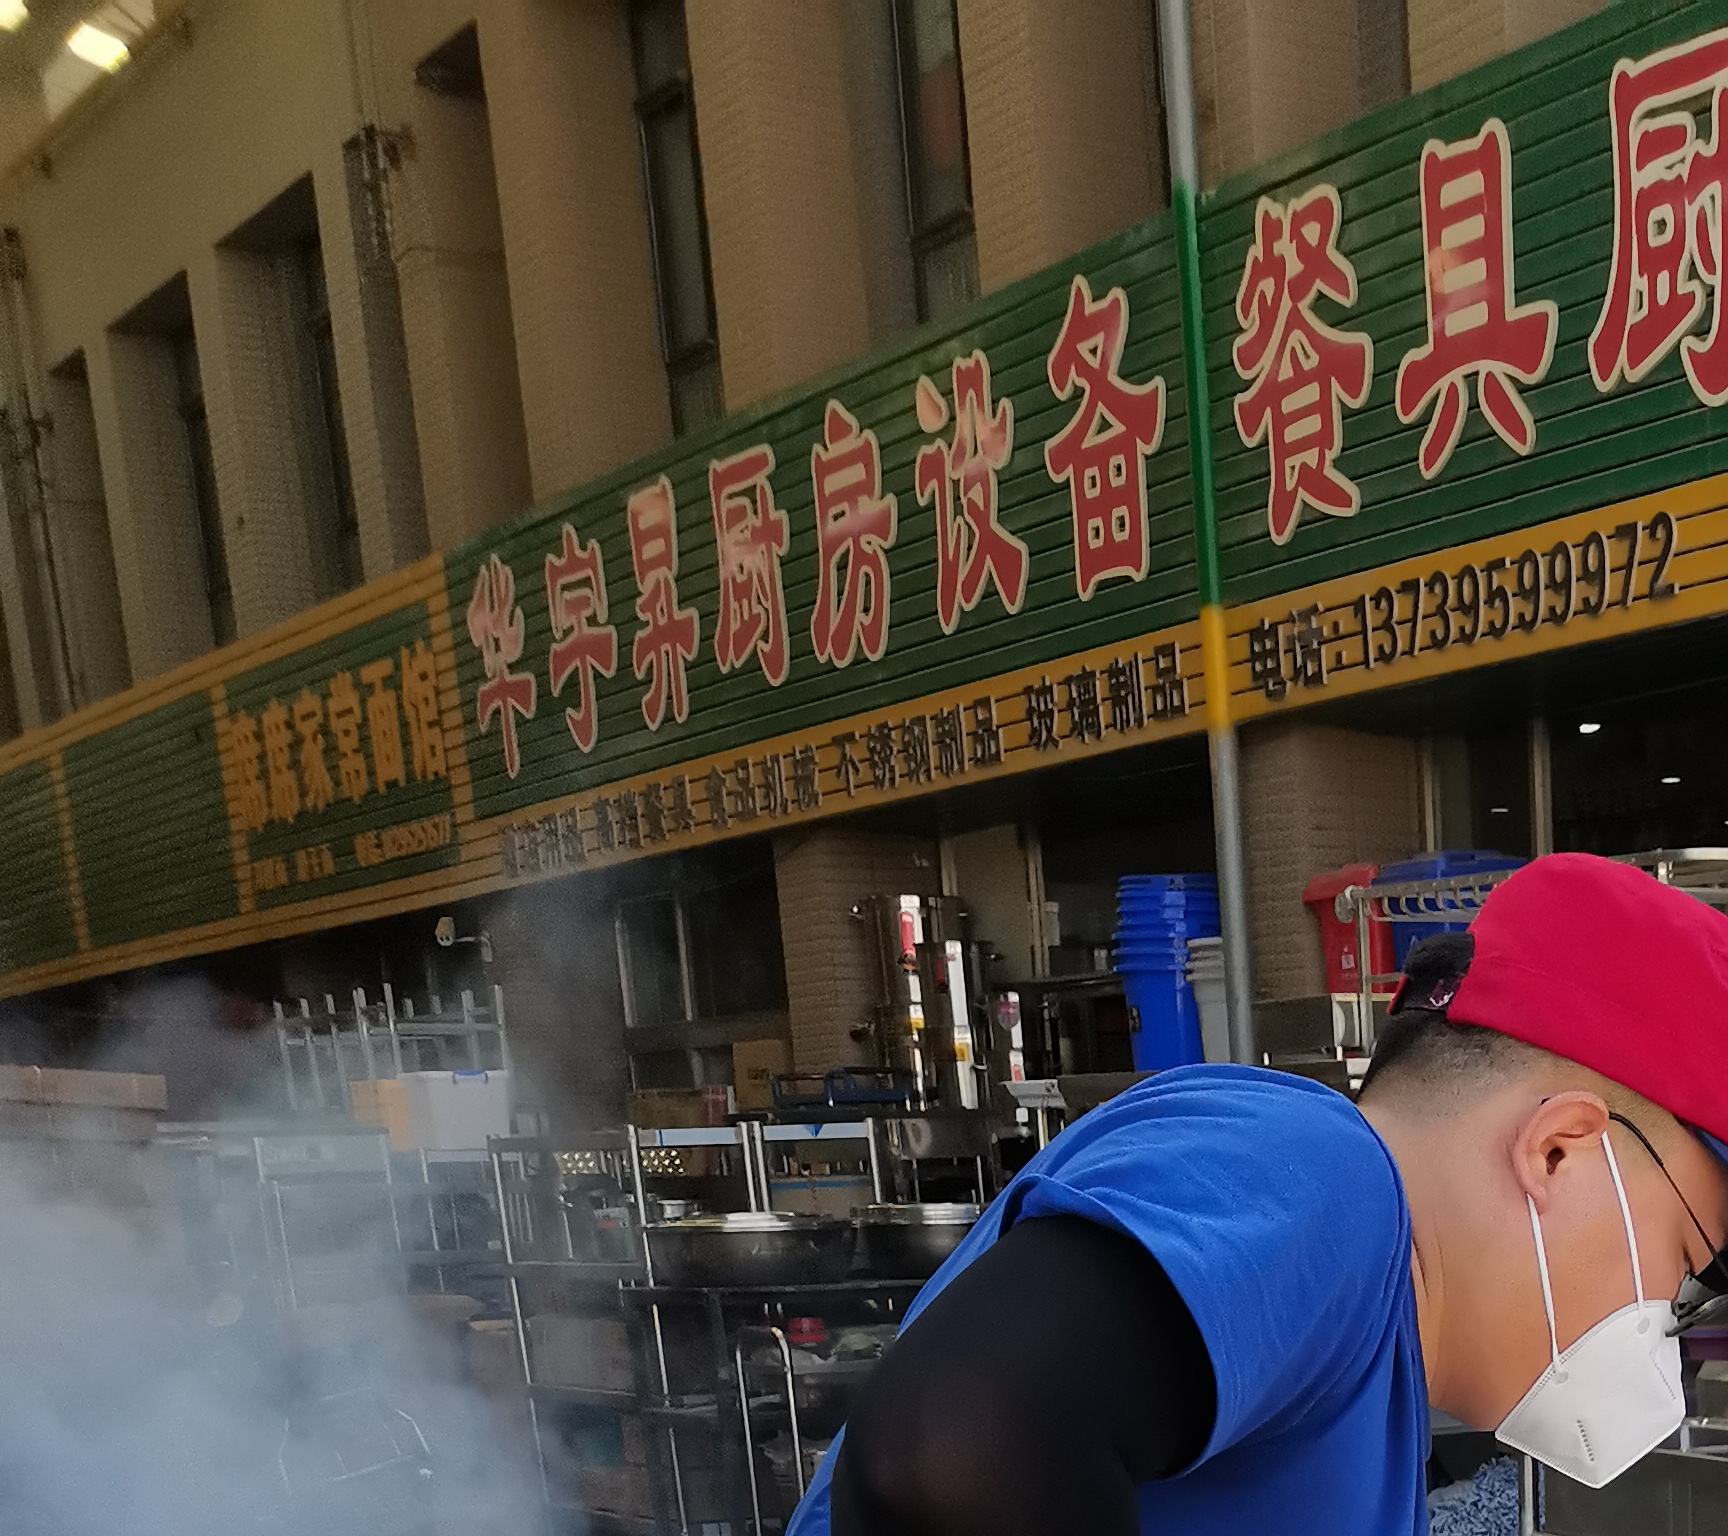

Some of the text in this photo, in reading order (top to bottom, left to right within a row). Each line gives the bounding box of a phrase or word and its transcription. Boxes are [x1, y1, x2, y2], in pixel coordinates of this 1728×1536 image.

[831, 695, 1005, 798] 不锈钢制品
[1022, 640, 1190, 752] 玻璃制品
